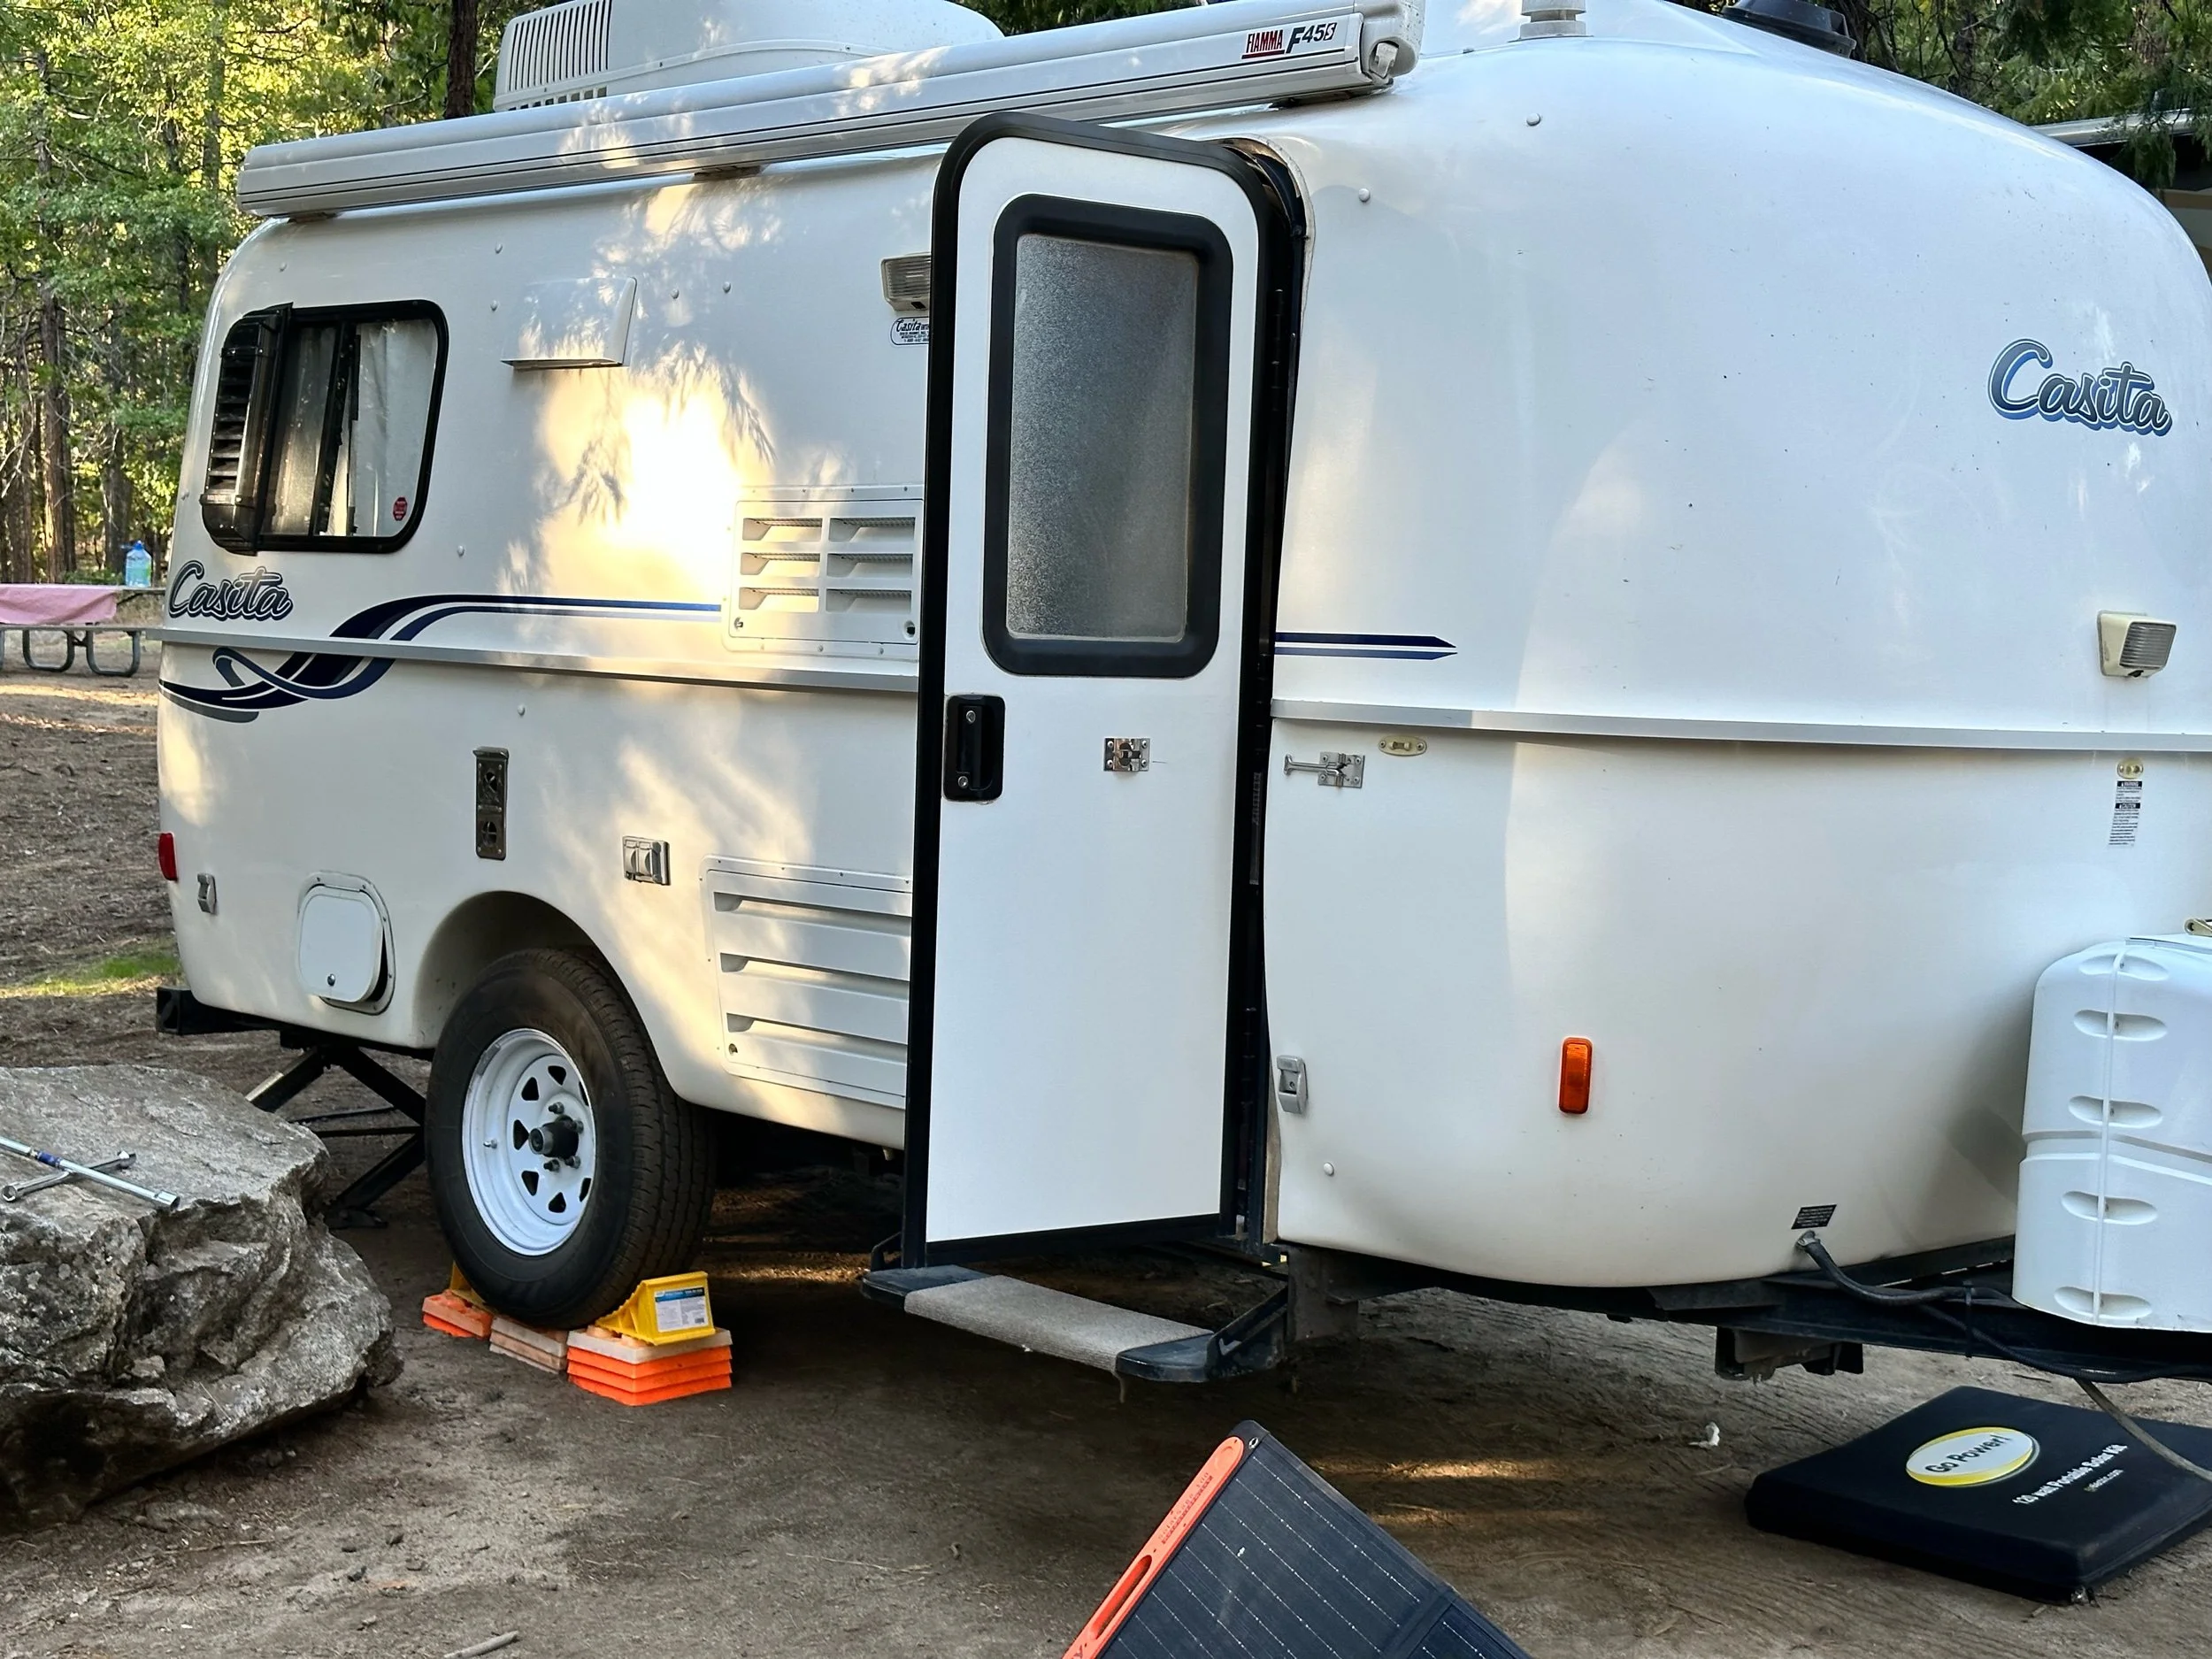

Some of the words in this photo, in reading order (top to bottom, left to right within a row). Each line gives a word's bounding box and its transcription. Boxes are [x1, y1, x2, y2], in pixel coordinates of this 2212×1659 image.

[1245, 29, 1283, 54] FIAMMA
[895, 319, 922, 333] Casita
[1988, 338, 2173, 437] Casita
[168, 559, 294, 622] Casita
[1924, 1462, 1960, 1473] Go
[2047, 1466, 2093, 1487] Portable
[2081, 1452, 2115, 1468] Solar
[2102, 1444, 2128, 1455] Kit
